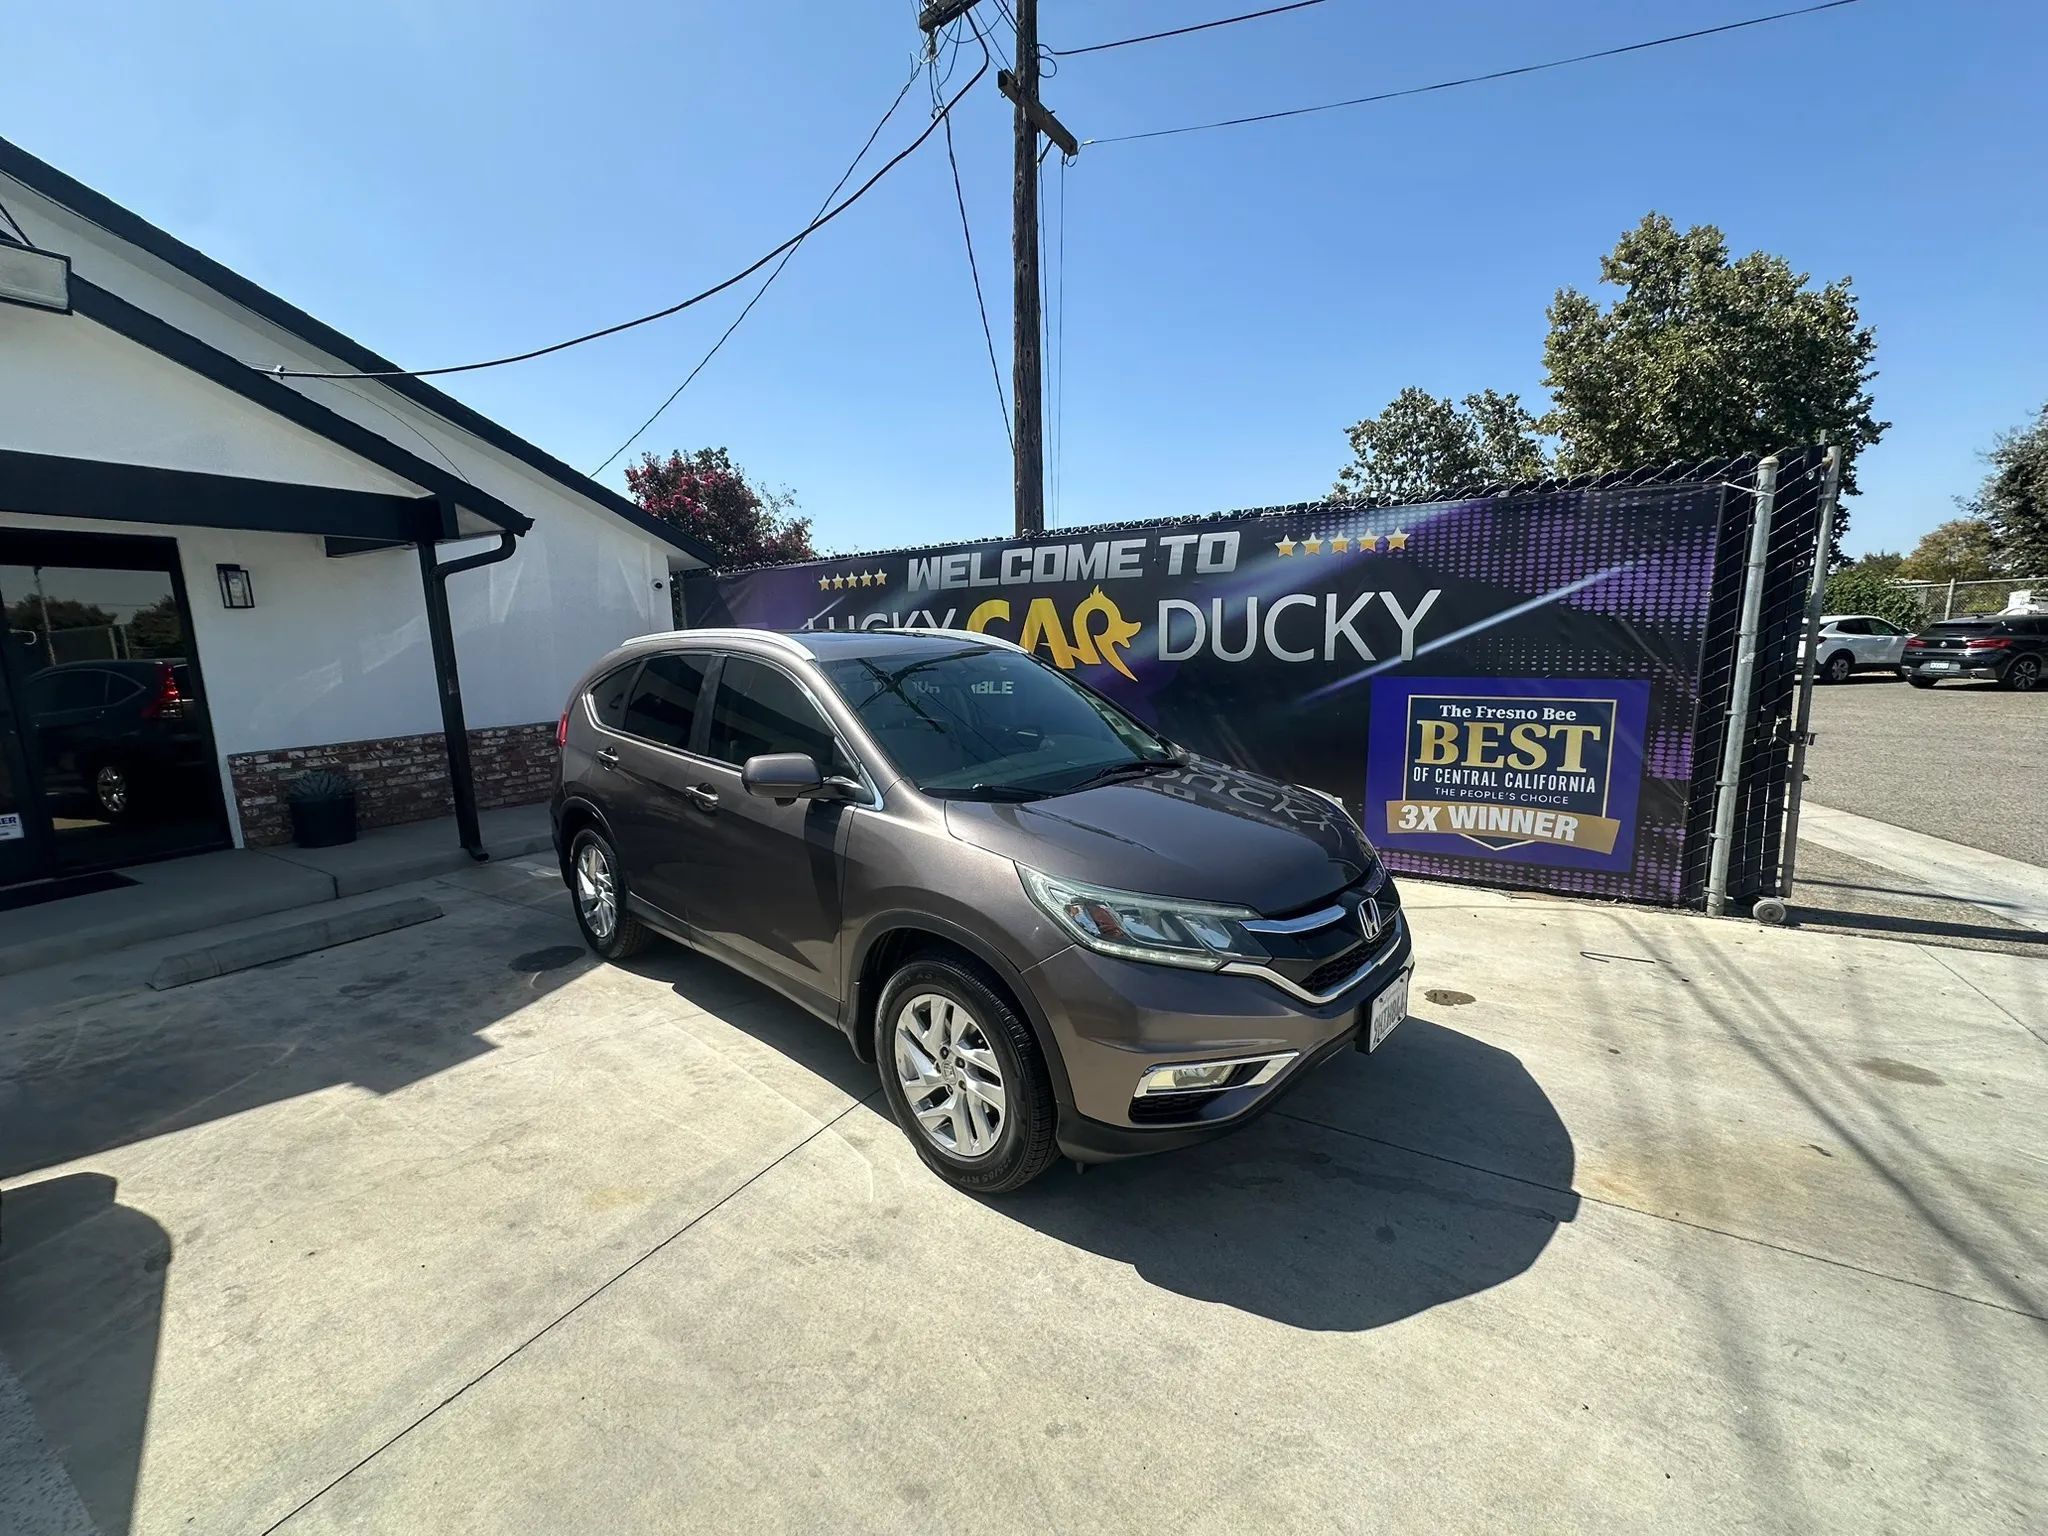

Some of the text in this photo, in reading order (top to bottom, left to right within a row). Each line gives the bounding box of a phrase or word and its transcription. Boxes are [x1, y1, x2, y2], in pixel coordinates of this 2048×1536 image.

[907, 531, 1241, 592] WELCOME TO
[1158, 589, 1442, 663] DUCKY
[1439, 704, 1577, 721] The Fresno Bee
[1414, 719, 1601, 773] BEST
[1413, 766, 1596, 793] OF CENTRAL CALIFORNIA
[1434, 787, 1569, 805] THE PEOPLE'S CHOICE
[1398, 804, 1580, 842] 3X WINNER
